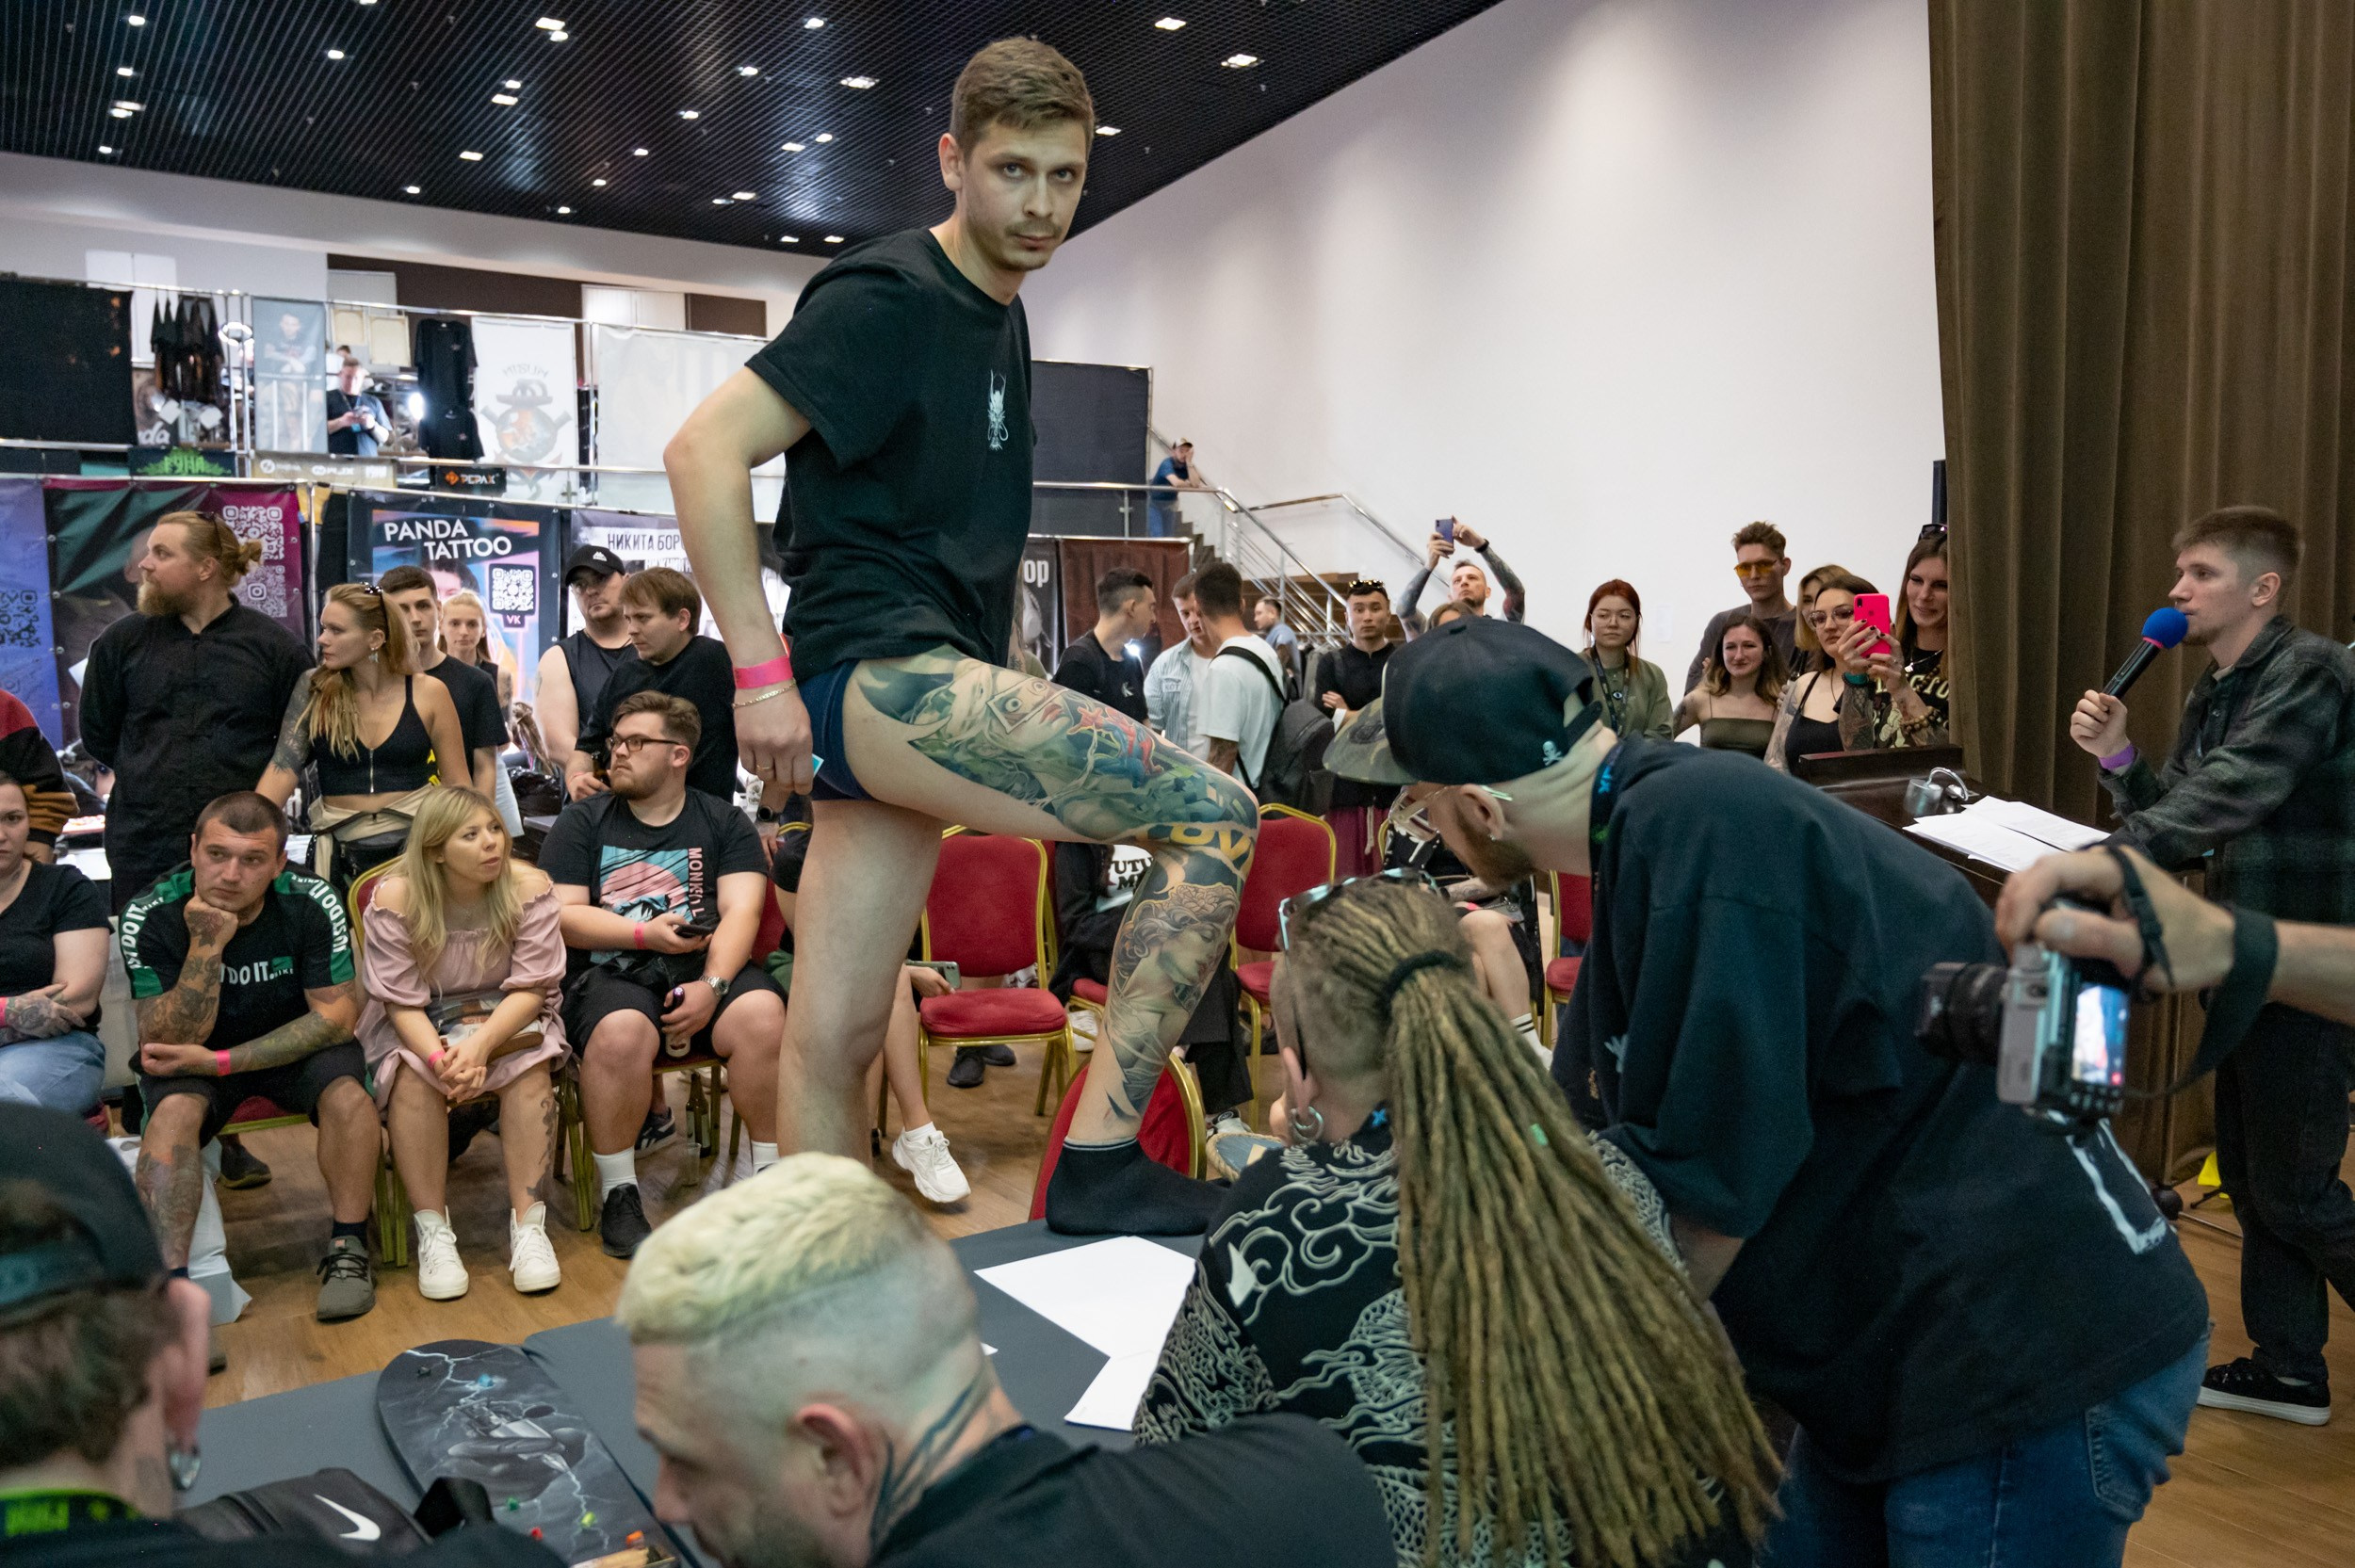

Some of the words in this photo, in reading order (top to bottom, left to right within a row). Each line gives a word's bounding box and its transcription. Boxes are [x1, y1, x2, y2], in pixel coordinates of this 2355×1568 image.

[384, 519, 468, 542] PANDA
[608, 533, 654, 550] НИКИТА
[424, 536, 512, 560] TATTOO
[506, 615, 521, 624] VK
[322, 893, 344, 921] DO
[122, 921, 140, 947] DO
[227, 966, 251, 985] DO
